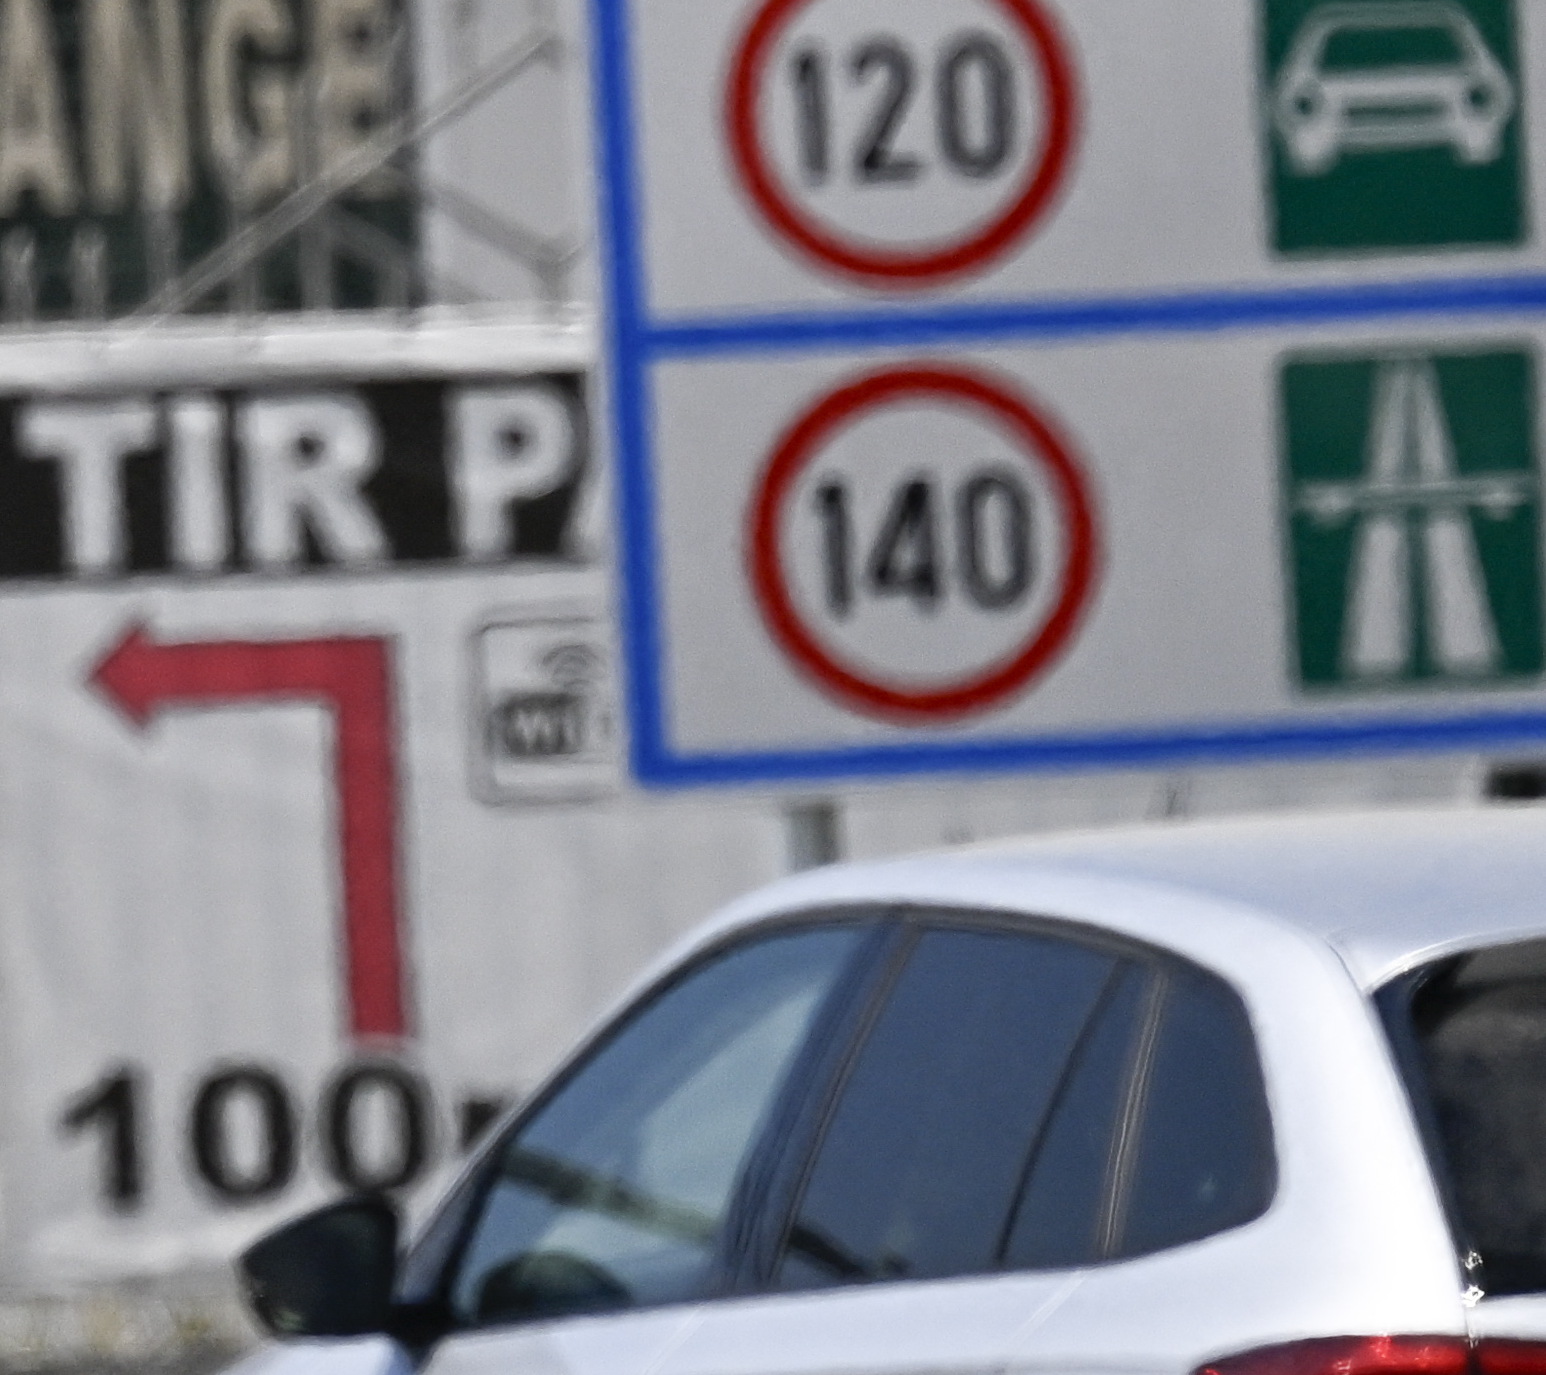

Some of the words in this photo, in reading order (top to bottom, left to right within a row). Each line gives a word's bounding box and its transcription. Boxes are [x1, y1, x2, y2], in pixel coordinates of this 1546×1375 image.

[788, 25, 1020, 189] 120
[20, 389, 388, 575] TIR
[810, 459, 1036, 625] 140
[56, 1059, 508, 1213] 100
